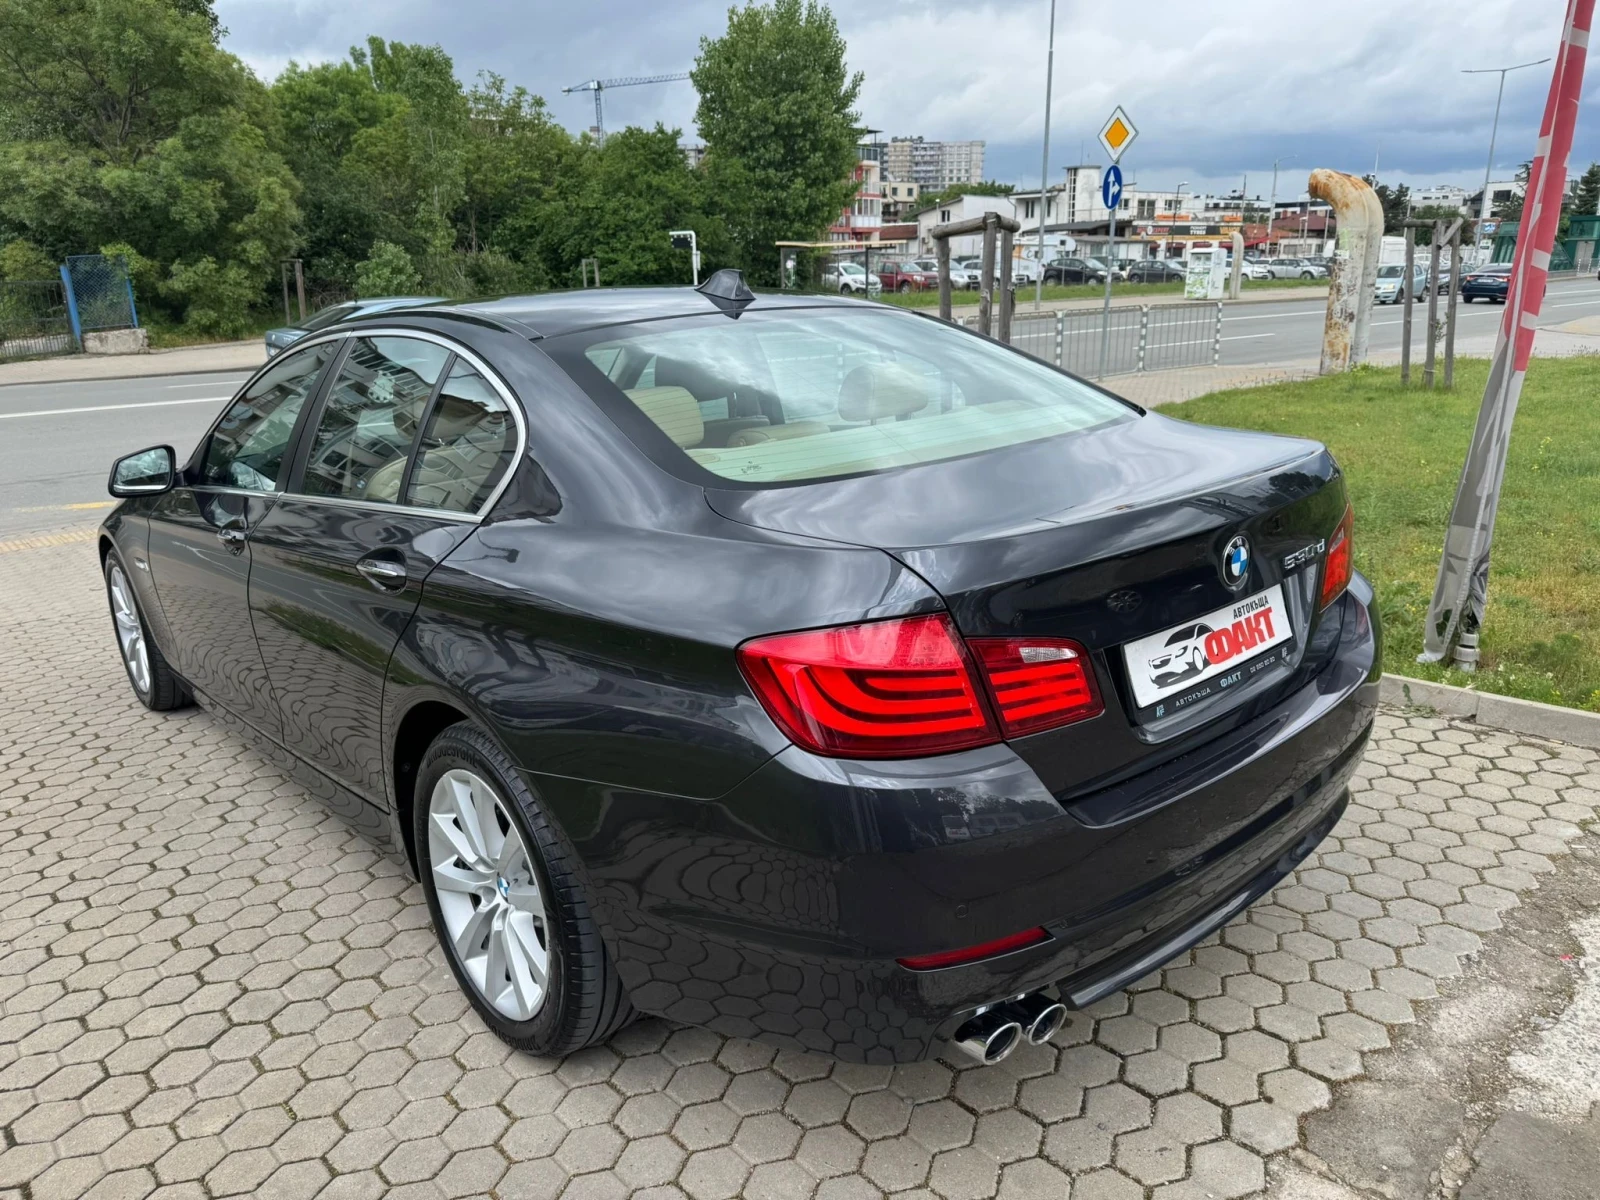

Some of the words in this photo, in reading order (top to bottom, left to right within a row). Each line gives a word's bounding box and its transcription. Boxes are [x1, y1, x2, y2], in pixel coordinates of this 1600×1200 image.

[1233, 595, 1269, 619] АВТОКЪЩА
[1204, 606, 1275, 664] ФАКТ
[1220, 672, 1241, 687] ФАКТ
